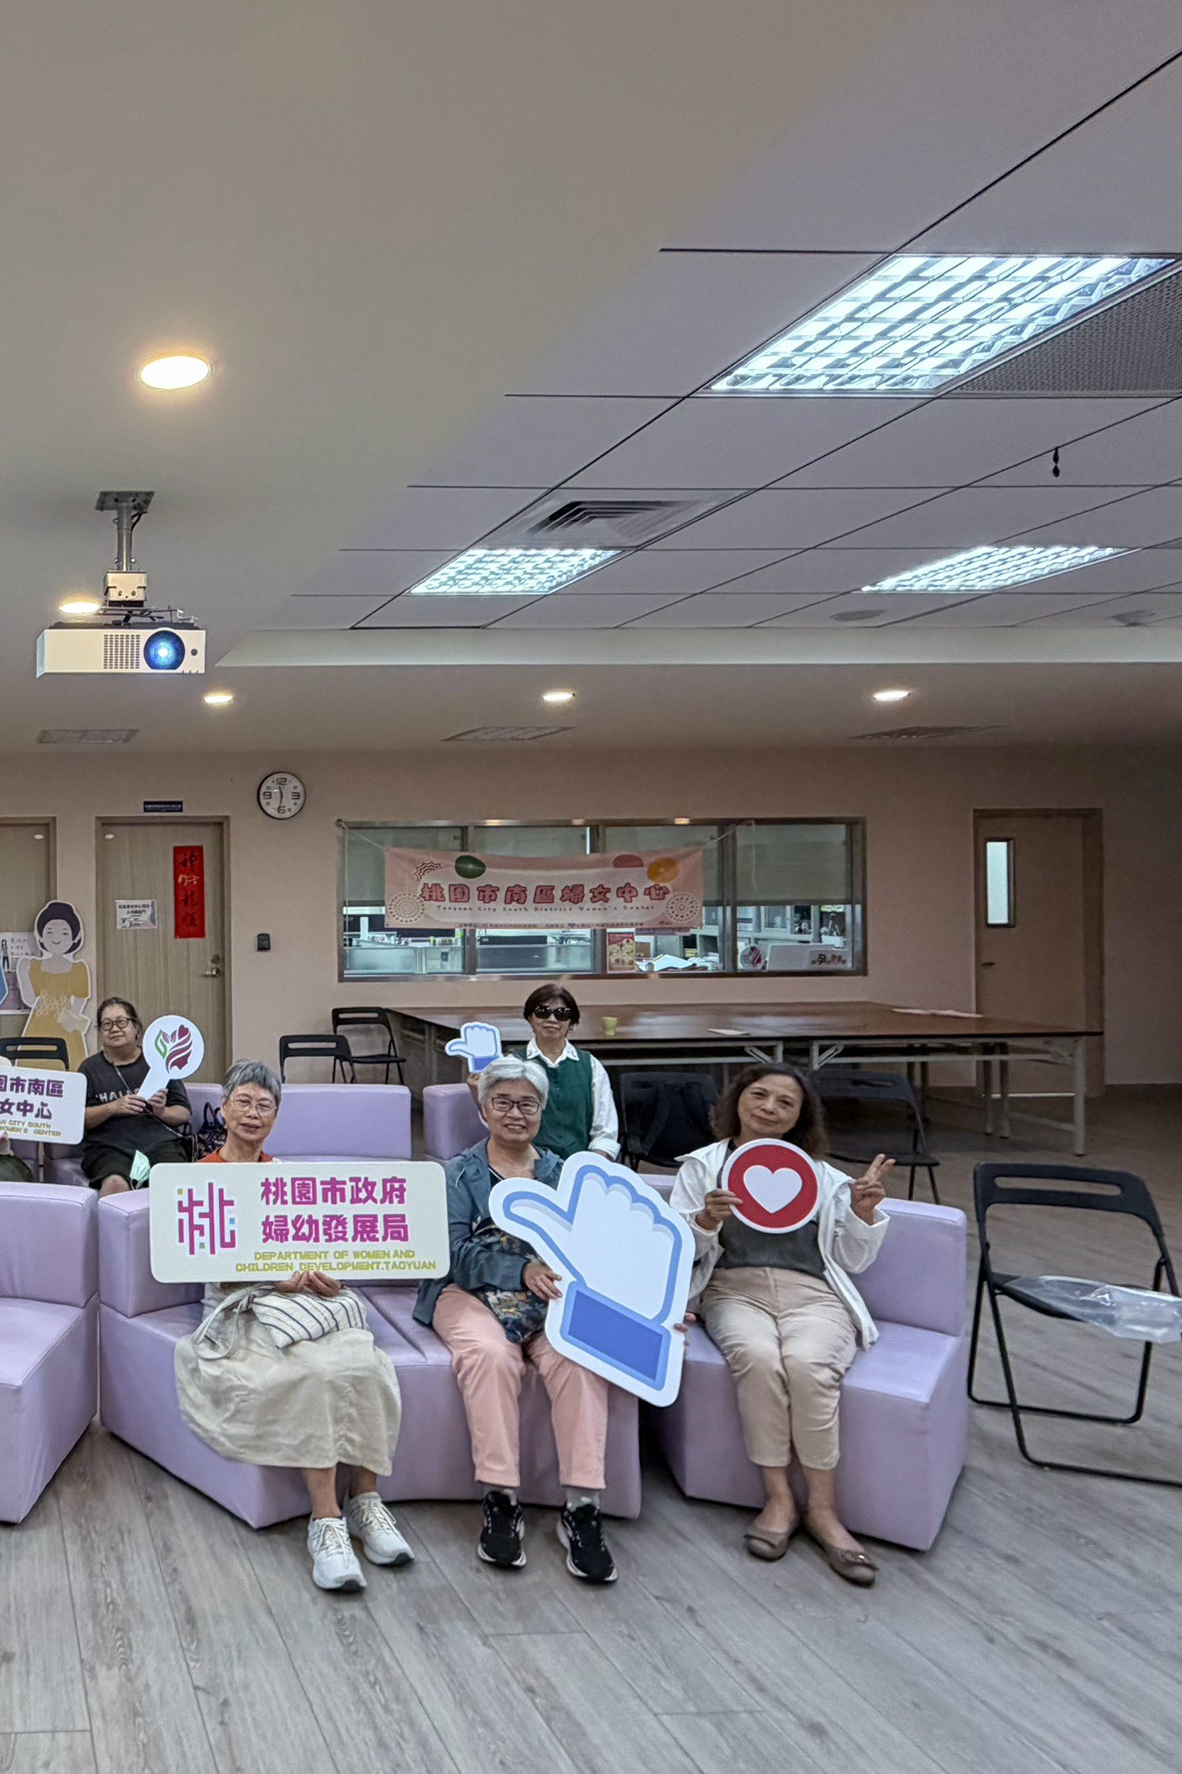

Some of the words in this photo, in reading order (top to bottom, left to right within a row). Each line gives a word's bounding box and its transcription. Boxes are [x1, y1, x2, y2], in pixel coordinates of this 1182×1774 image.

[276, 777, 287, 785] 12
[263, 791, 272, 800] 9
[291, 791, 301, 800] 3
[277, 805, 286, 814] 6
[419, 882, 670, 905] 桃園市南區婦女中心
[8, 1119, 26, 1127] CITY
[260, 1176, 408, 1206] 桃園市政府
[261, 1213, 410, 1244] 婦幼發展局
[254, 1251, 329, 1261] DEPARTMENT
[333, 1251, 349, 1260] OF
[353, 1250, 391, 1260] WOMEN
[393, 1249, 416, 1259] AND
[235, 1262, 294, 1273] CHILDREN
